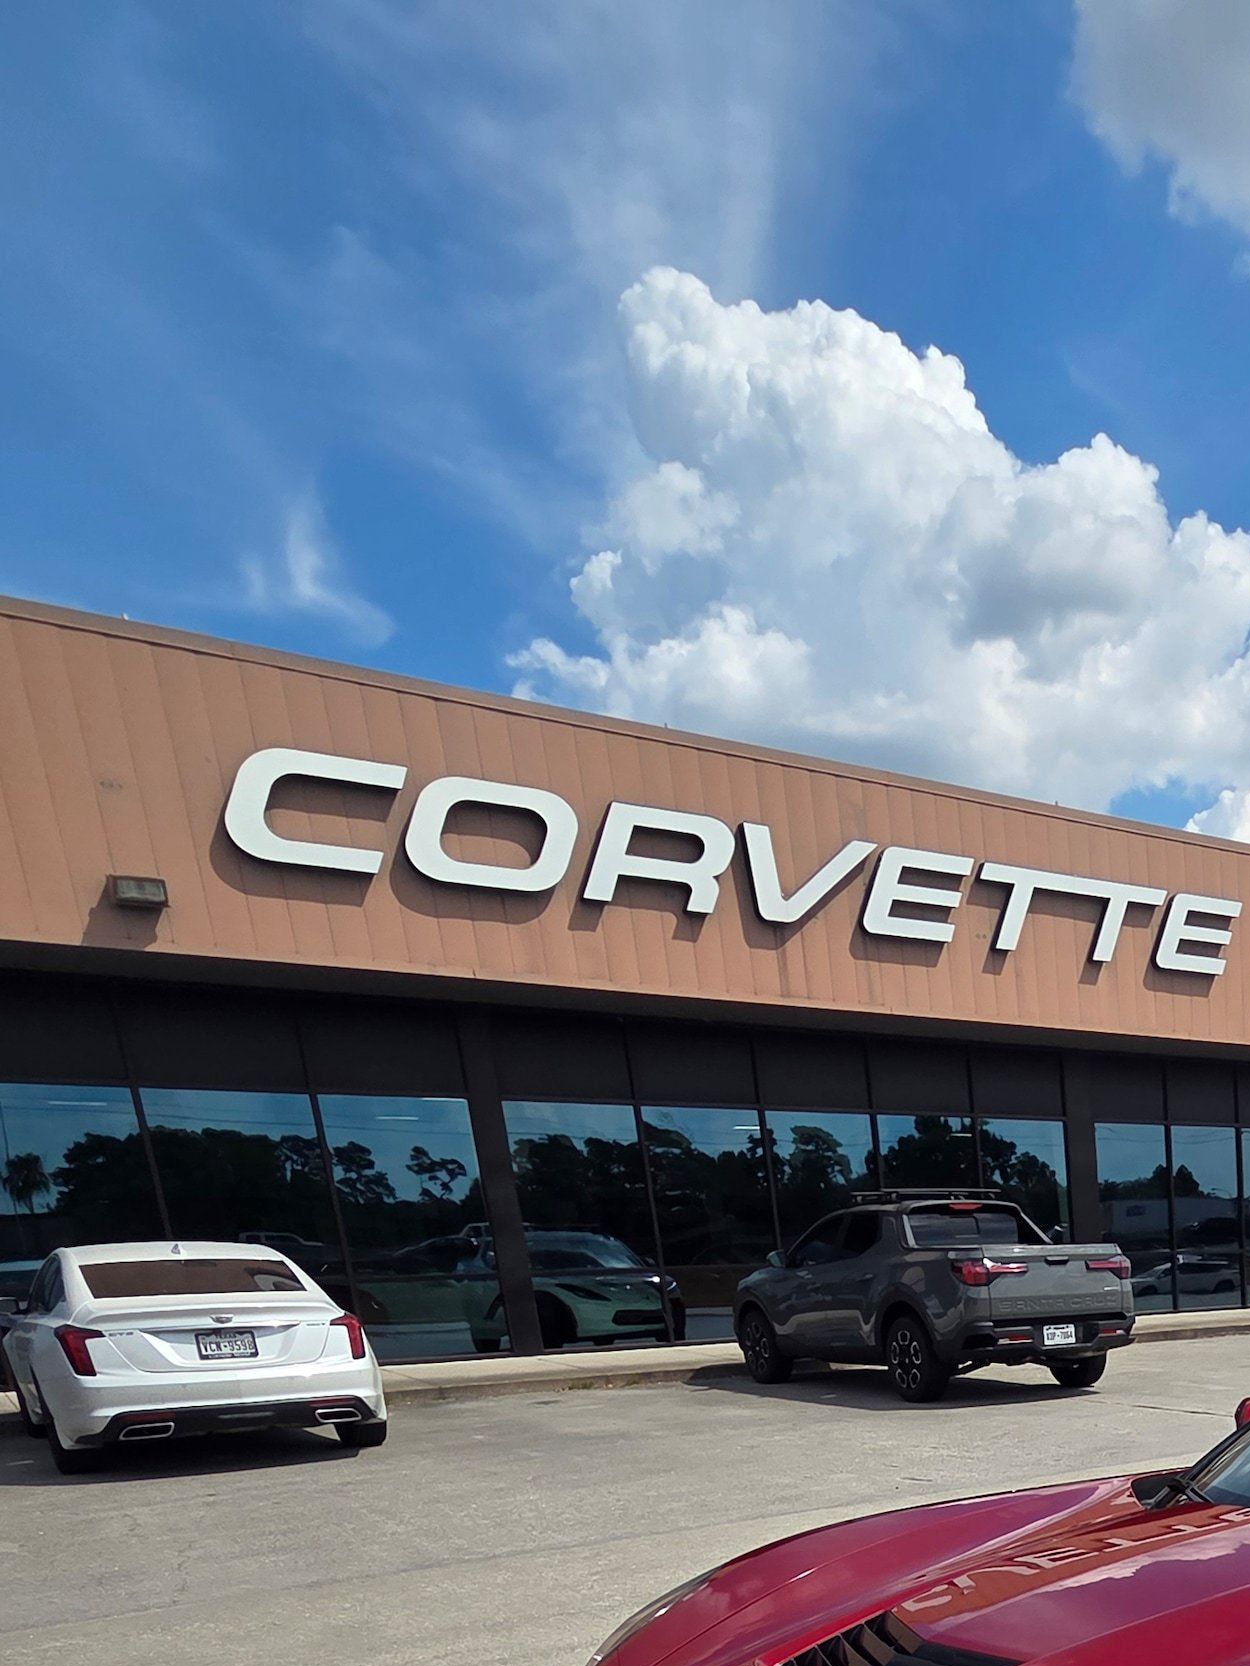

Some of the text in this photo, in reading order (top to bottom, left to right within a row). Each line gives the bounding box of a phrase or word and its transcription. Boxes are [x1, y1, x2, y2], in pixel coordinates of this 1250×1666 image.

[225, 747, 1243, 976] CORVETTE
[999, 1296, 1117, 1312] SANTA CRUZ
